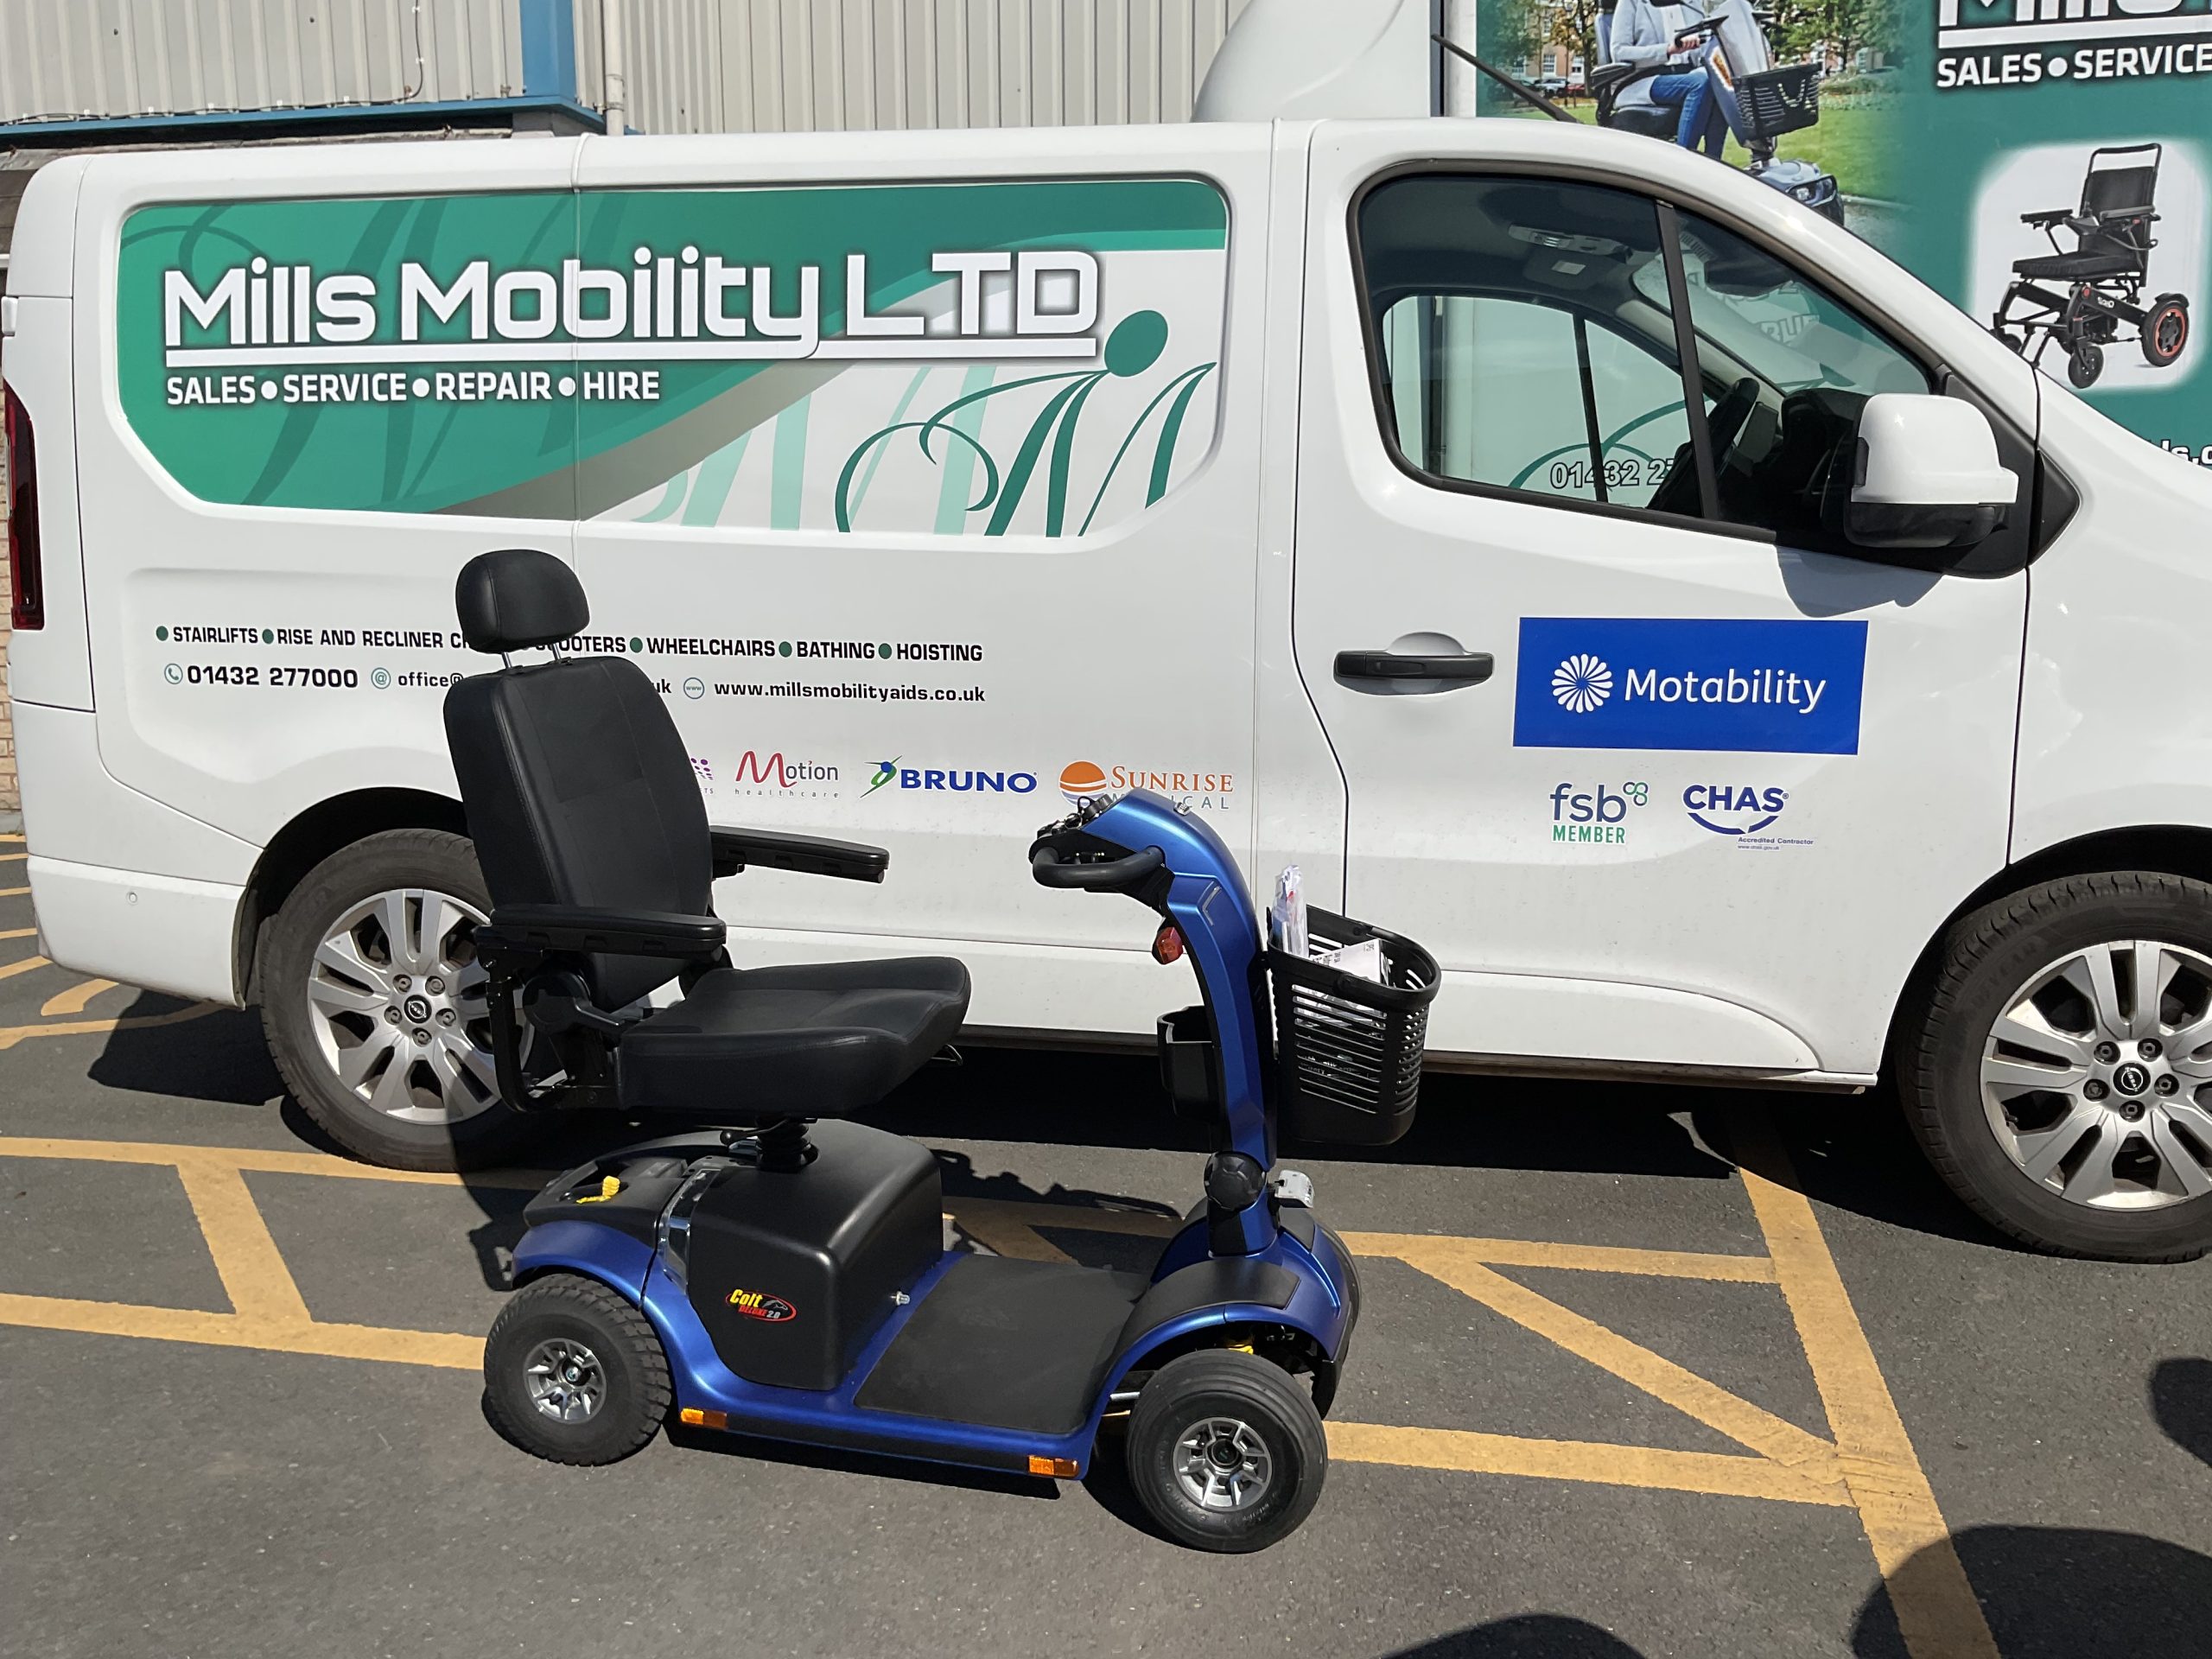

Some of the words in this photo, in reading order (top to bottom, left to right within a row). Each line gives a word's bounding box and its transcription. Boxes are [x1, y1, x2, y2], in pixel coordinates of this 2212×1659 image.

[1937, 53, 2043, 87] SALES
[2073, 42, 2212, 79] SERVICE
[164, 257, 377, 347] Mills
[401, 245, 819, 359] Mobility
[846, 251, 1099, 336] LTD
[167, 374, 257, 406] SALES
[283, 372, 407, 404] SERVICE
[435, 371, 552, 402] REPAIR
[582, 370, 660, 401] HIRE
[173, 626, 258, 644] STAIRLIFTS
[276, 628, 313, 645] RISE
[320, 630, 355, 646] AND
[363, 631, 443, 648] RECLINER
[646, 638, 775, 657] WHEELCHAIRS
[797, 641, 875, 659] BATHING
[897, 643, 983, 661] HOISTING
[188, 665, 259, 685] 01432
[270, 667, 358, 689] 277000
[714, 681, 986, 702] www.millsmobilityaids.co.uk
[1624, 669, 1827, 715] Motability
[735, 750, 839, 788] Motion
[900, 768, 1038, 793] BRUNO
[1111, 766, 1234, 792] SUNRISE
[734, 788, 839, 798] healthcare
[1550, 783, 1627, 823] fsb
[1553, 825, 1626, 844] MEMBER
[730, 1289, 762, 1307] Colt
